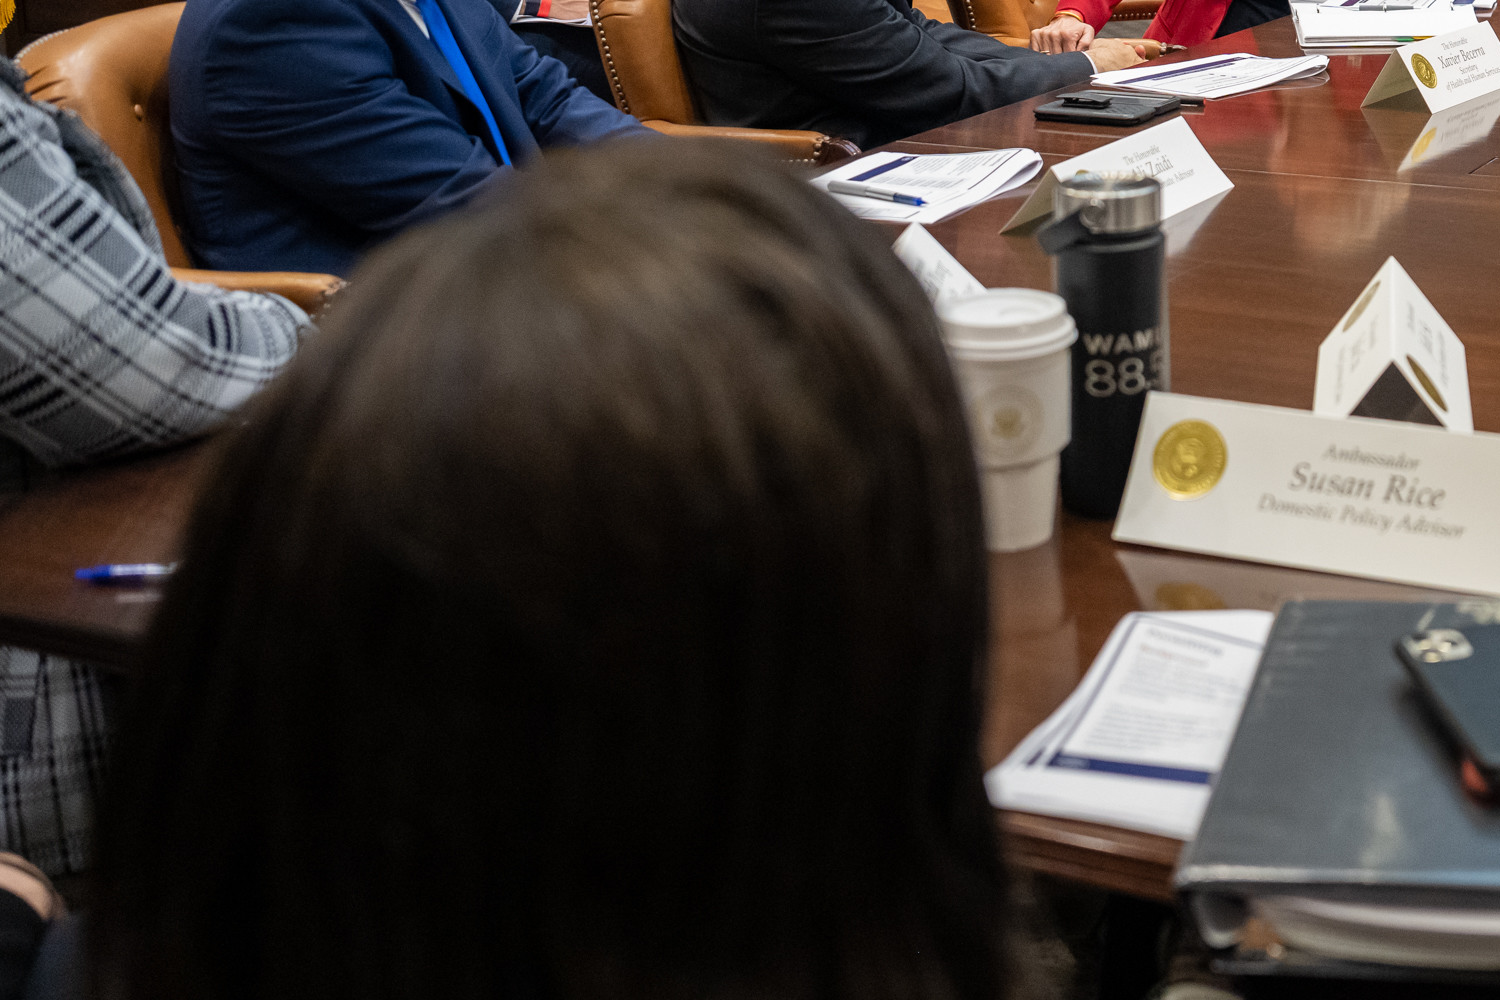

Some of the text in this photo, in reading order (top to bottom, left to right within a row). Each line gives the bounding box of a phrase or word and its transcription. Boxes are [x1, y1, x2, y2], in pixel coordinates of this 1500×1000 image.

[1437, 46, 1486, 69] Xavier Becerra
[1459, 64, 1479, 75] Secretary
[1450, 78, 1464, 89] Health
[1470, 72, 1486, 82] Human
[1485, 66, 1500, 77] Services
[1145, 154, 1174, 178] Zaidi
[1321, 442, 1421, 472] Ambassador
[1287, 460, 1448, 511] Susan Rice
[1256, 491, 1337, 521] Domestic
[1337, 503, 1394, 536] Policy
